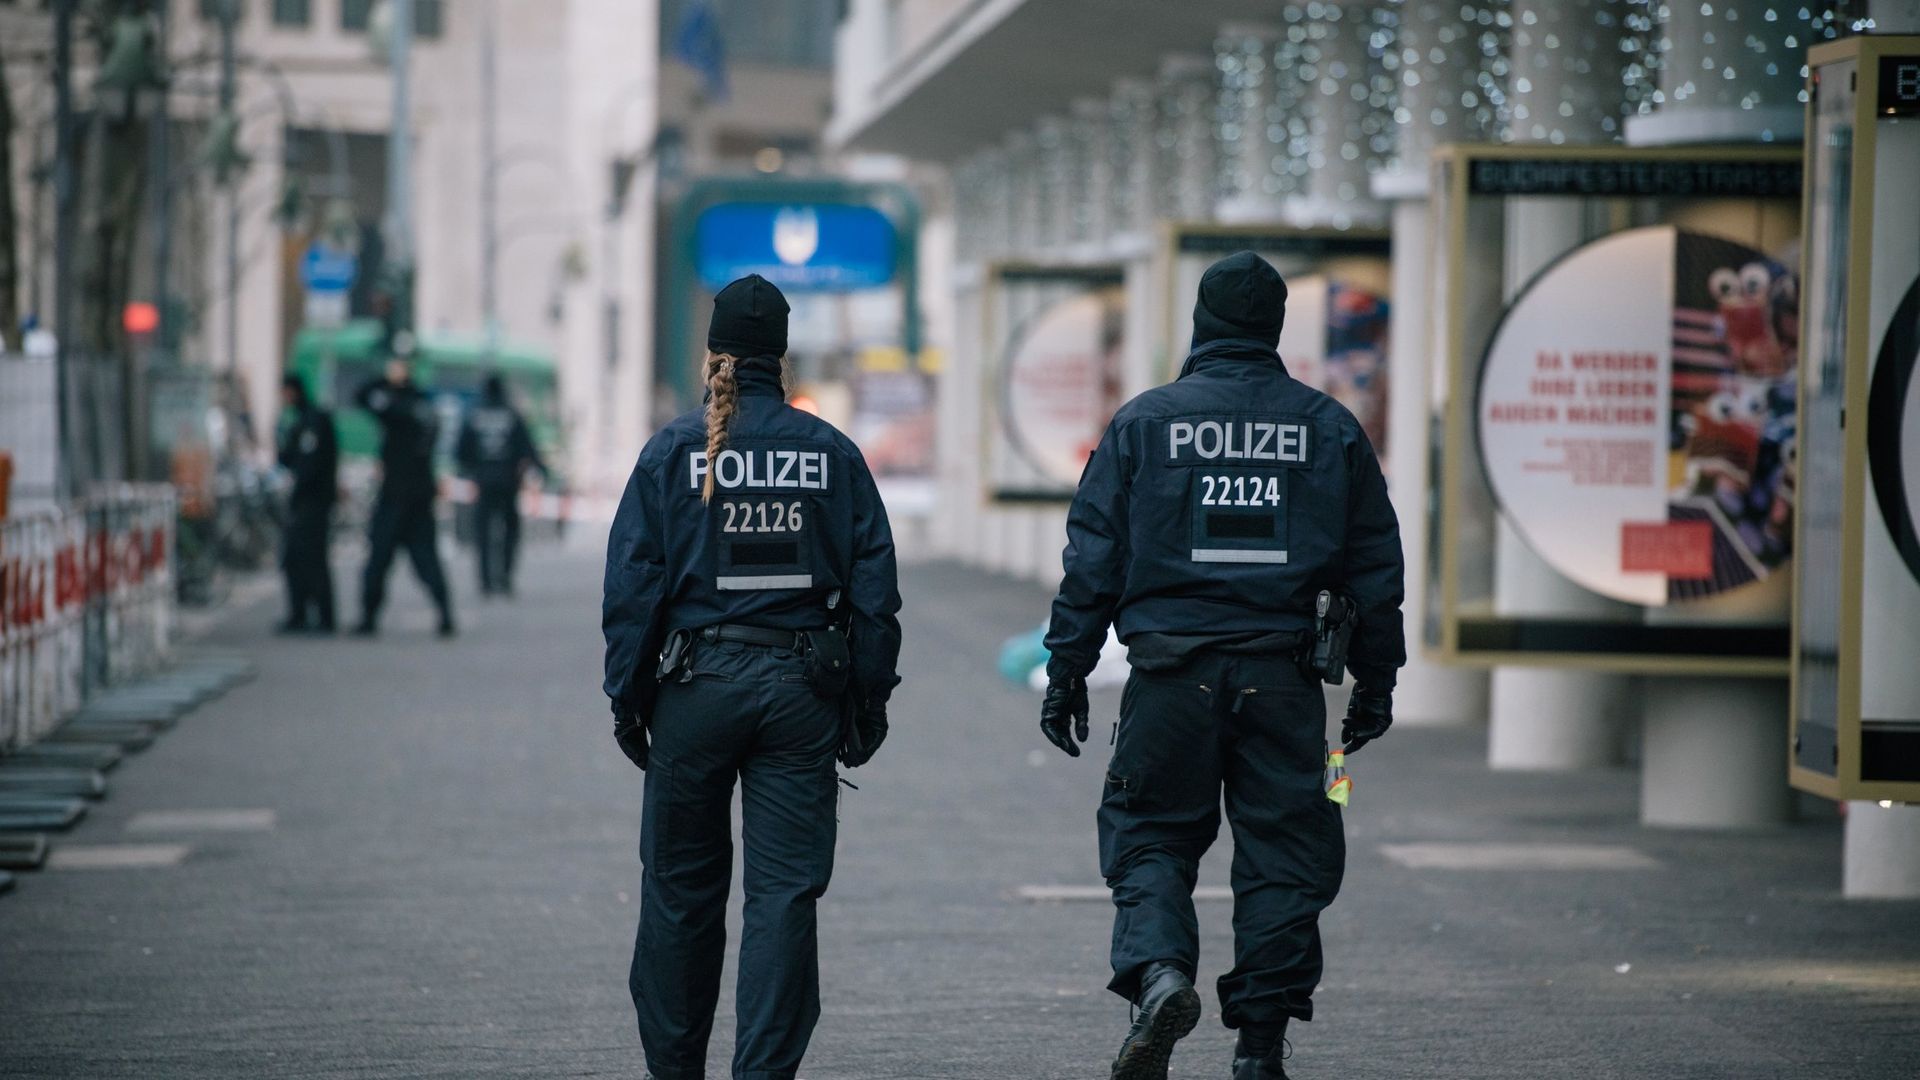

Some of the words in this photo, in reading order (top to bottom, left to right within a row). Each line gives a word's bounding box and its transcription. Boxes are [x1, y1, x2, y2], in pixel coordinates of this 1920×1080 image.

[1571, 352, 1658, 372] WERDEN
[1585, 379, 1657, 398] LIEBEN
[1491, 403, 1558, 423] AUGEN
[1567, 405, 1656, 425] MACHEN
[1169, 420, 1308, 462] POLIZEI
[689, 449, 829, 490] POLIZEI
[1201, 475, 1281, 507] 22124
[722, 501, 804, 533] 22126
